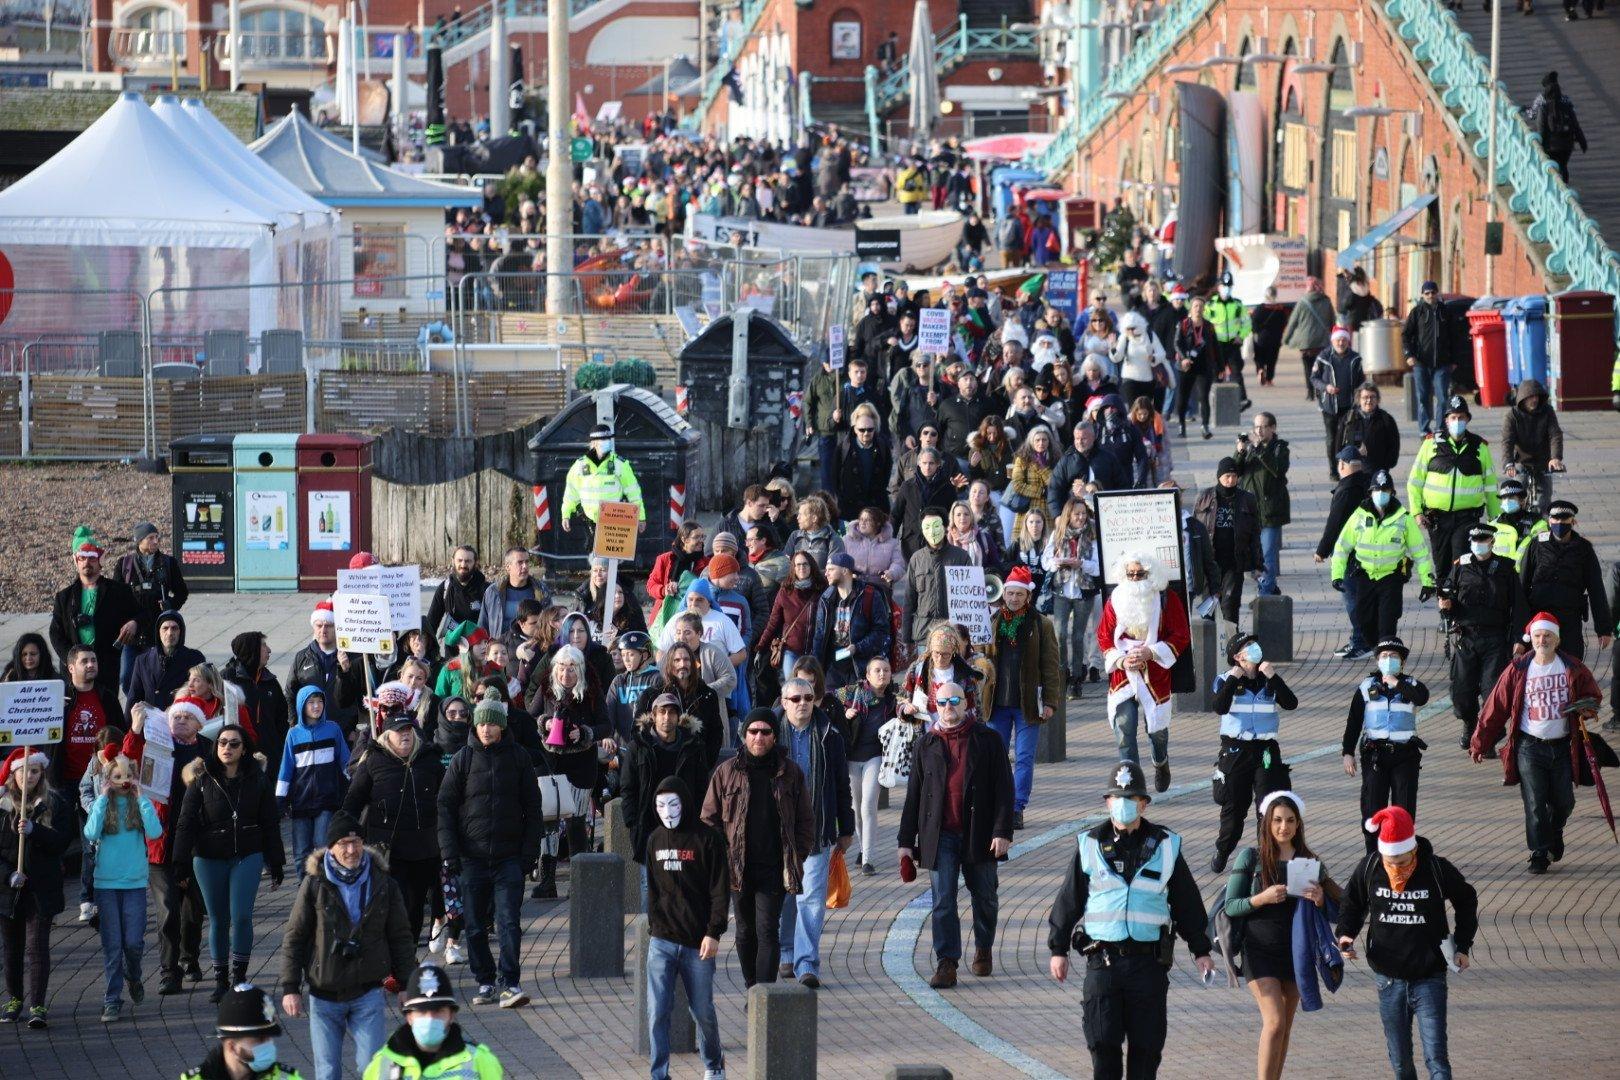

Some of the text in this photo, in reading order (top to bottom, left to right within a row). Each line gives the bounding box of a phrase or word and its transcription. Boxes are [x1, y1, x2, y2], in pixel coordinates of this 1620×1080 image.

[1107, 517, 1127, 526] NO!
[1132, 514, 1153, 525] NO!
[950, 600, 987, 610] FROM COVID
[345, 617, 382, 625] Christmas
[975, 614, 983, 622] DO
[984, 625, 990, 633] A
[1526, 674, 1568, 693] RADIO
[1527, 688, 1568, 706] FREE
[1538, 705, 1561, 720] UK
[1375, 887, 1429, 900] JUSTICE
[1379, 913, 1427, 924] AMELIA
